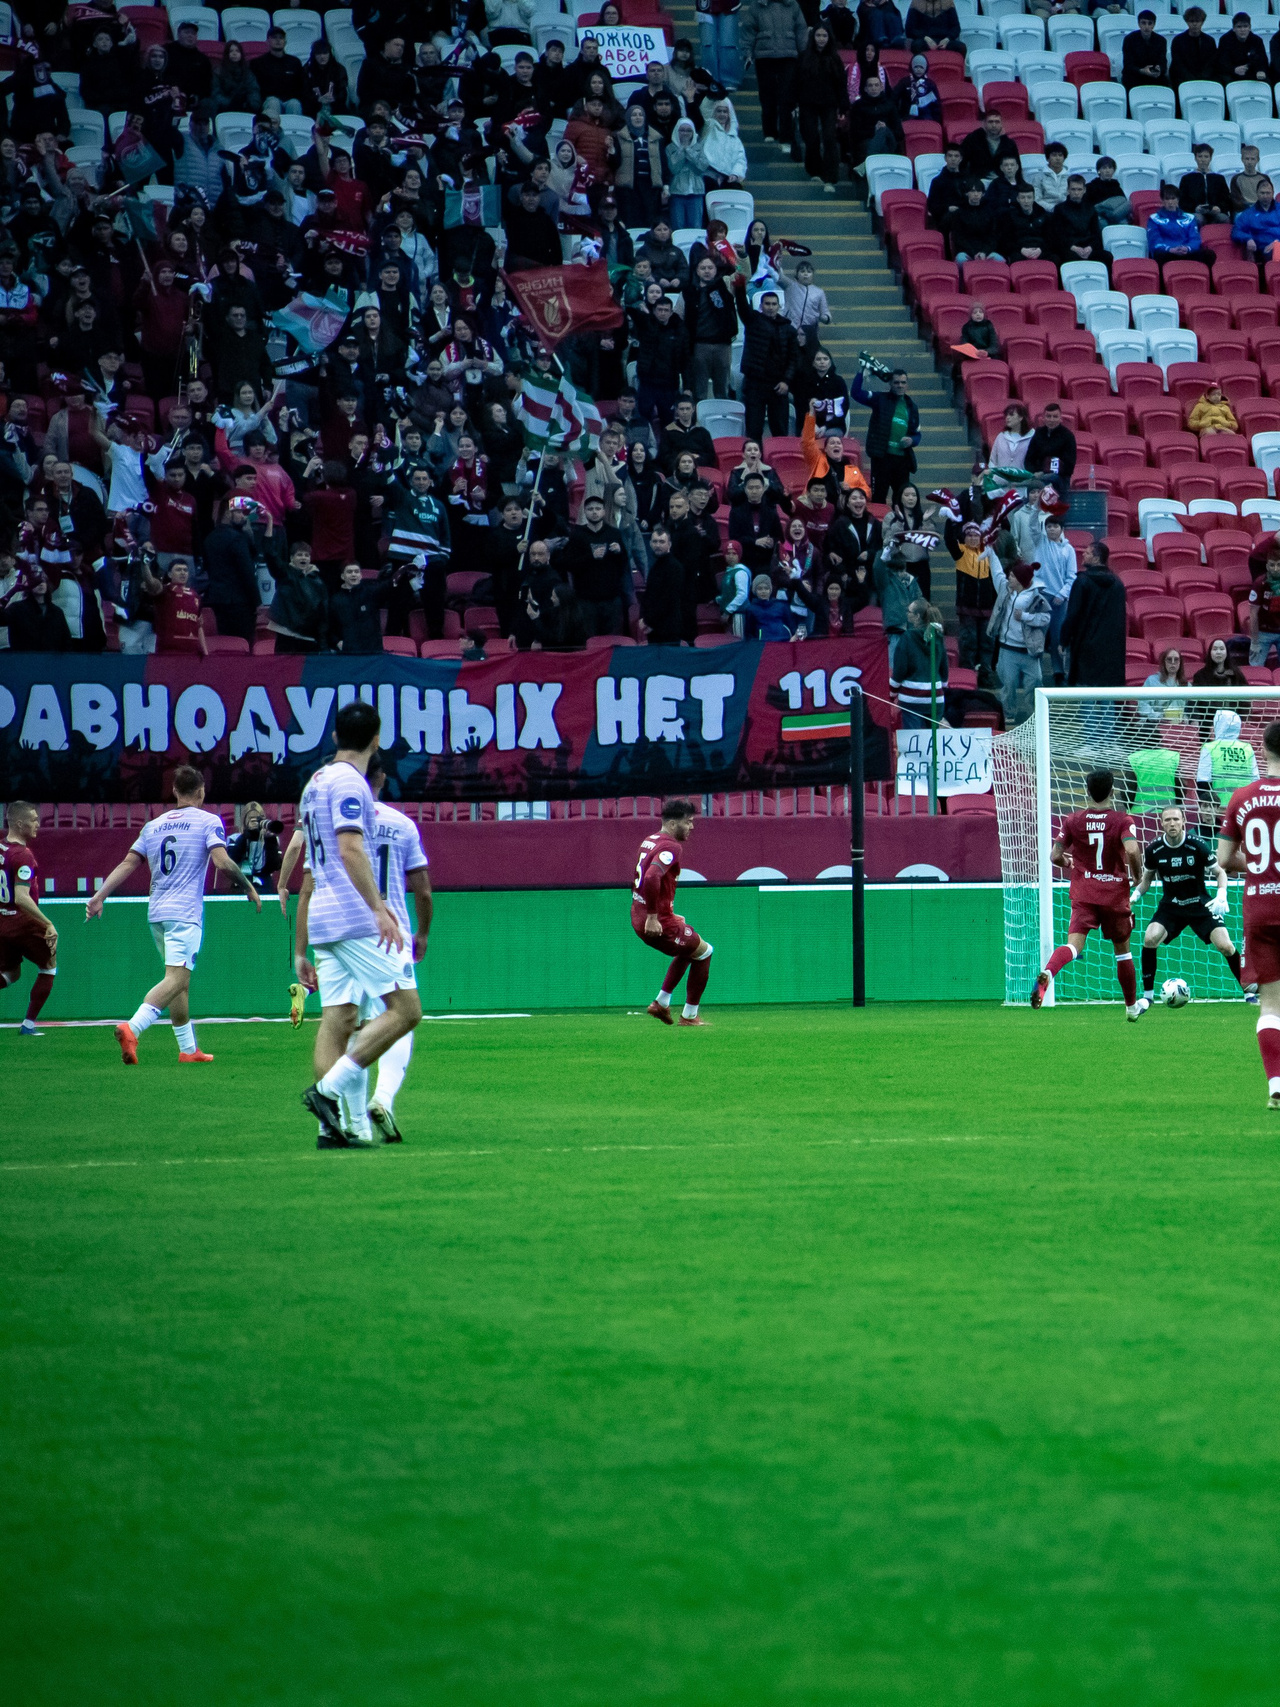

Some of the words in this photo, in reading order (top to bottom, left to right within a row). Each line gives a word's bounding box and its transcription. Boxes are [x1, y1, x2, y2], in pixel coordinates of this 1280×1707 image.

[779, 666, 862, 710] 116
[596, 673, 735, 745] НЕТ
[1086, 822, 1106, 831] НАЧО
[160, 835, 177, 876] 6
[1088, 832, 1104, 870] 7
